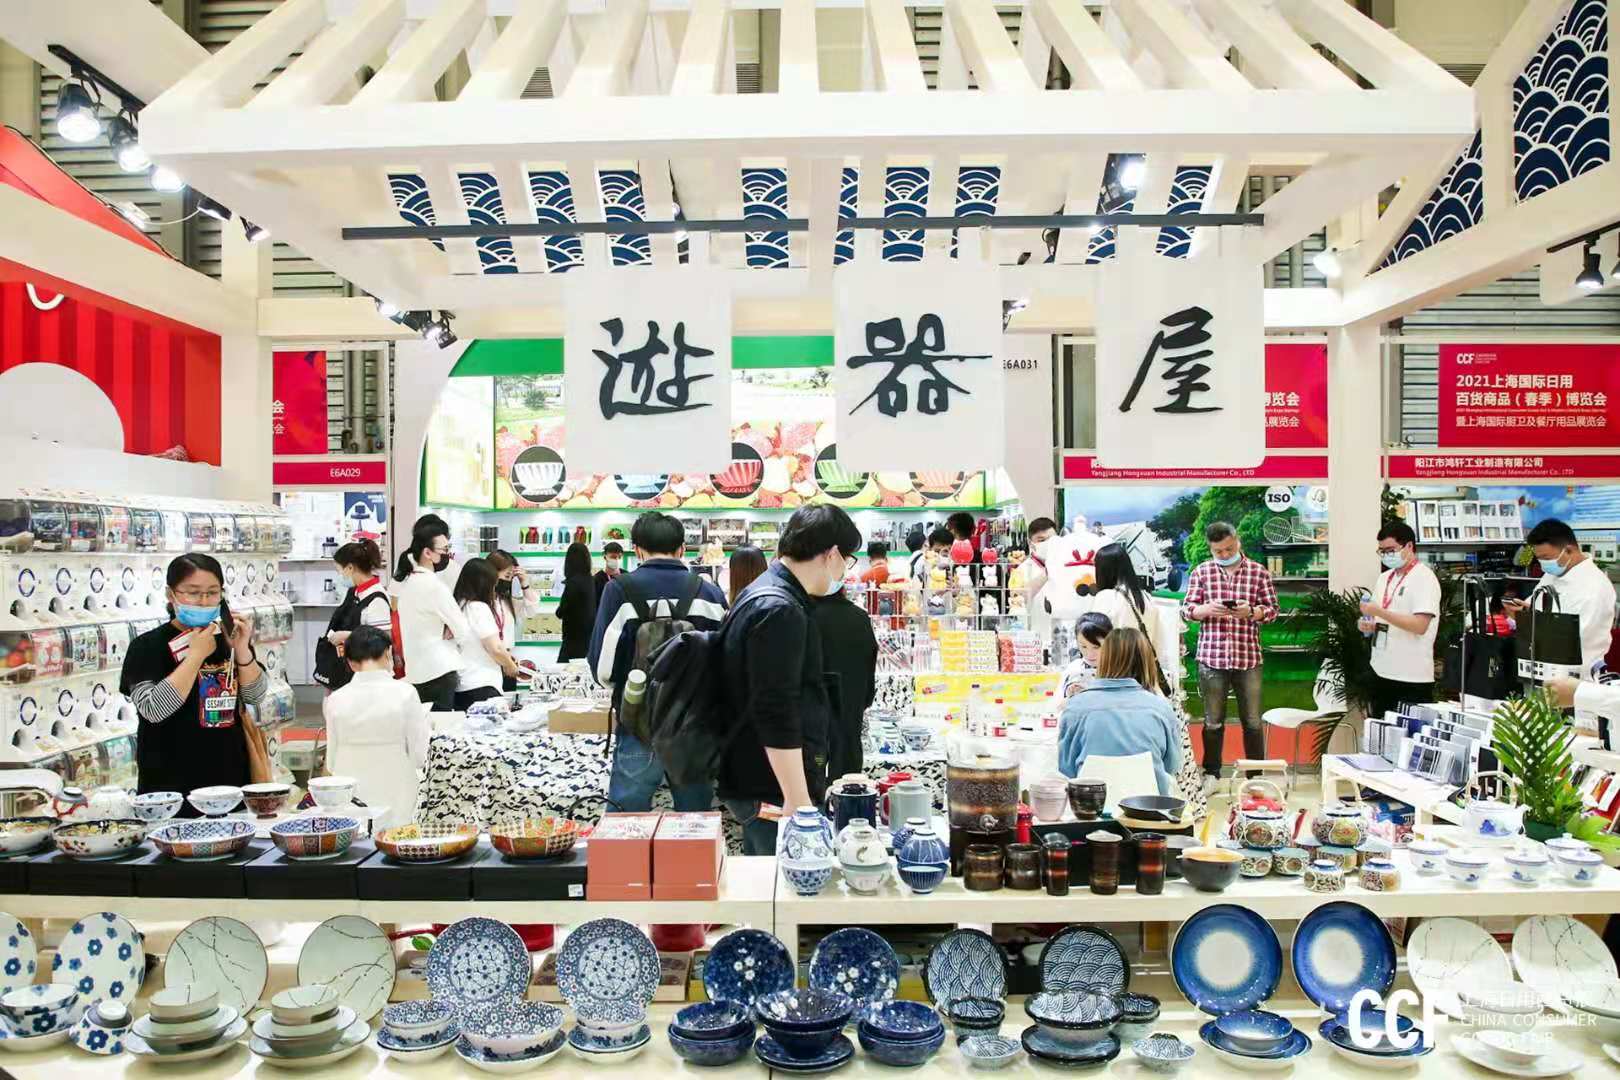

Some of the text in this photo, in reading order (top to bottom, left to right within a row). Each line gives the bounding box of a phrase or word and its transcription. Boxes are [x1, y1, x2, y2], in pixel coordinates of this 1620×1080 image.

[847, 313, 992, 418] 器
[1119, 306, 1223, 413] 屋
[1456, 353, 1475, 364] CCF
[1456, 374, 1574, 388] 2021上海国际日用
[1264, 416, 1300, 427] 展览会
[329, 467, 361, 478] E6A029
[1267, 493, 1291, 503] ISO
